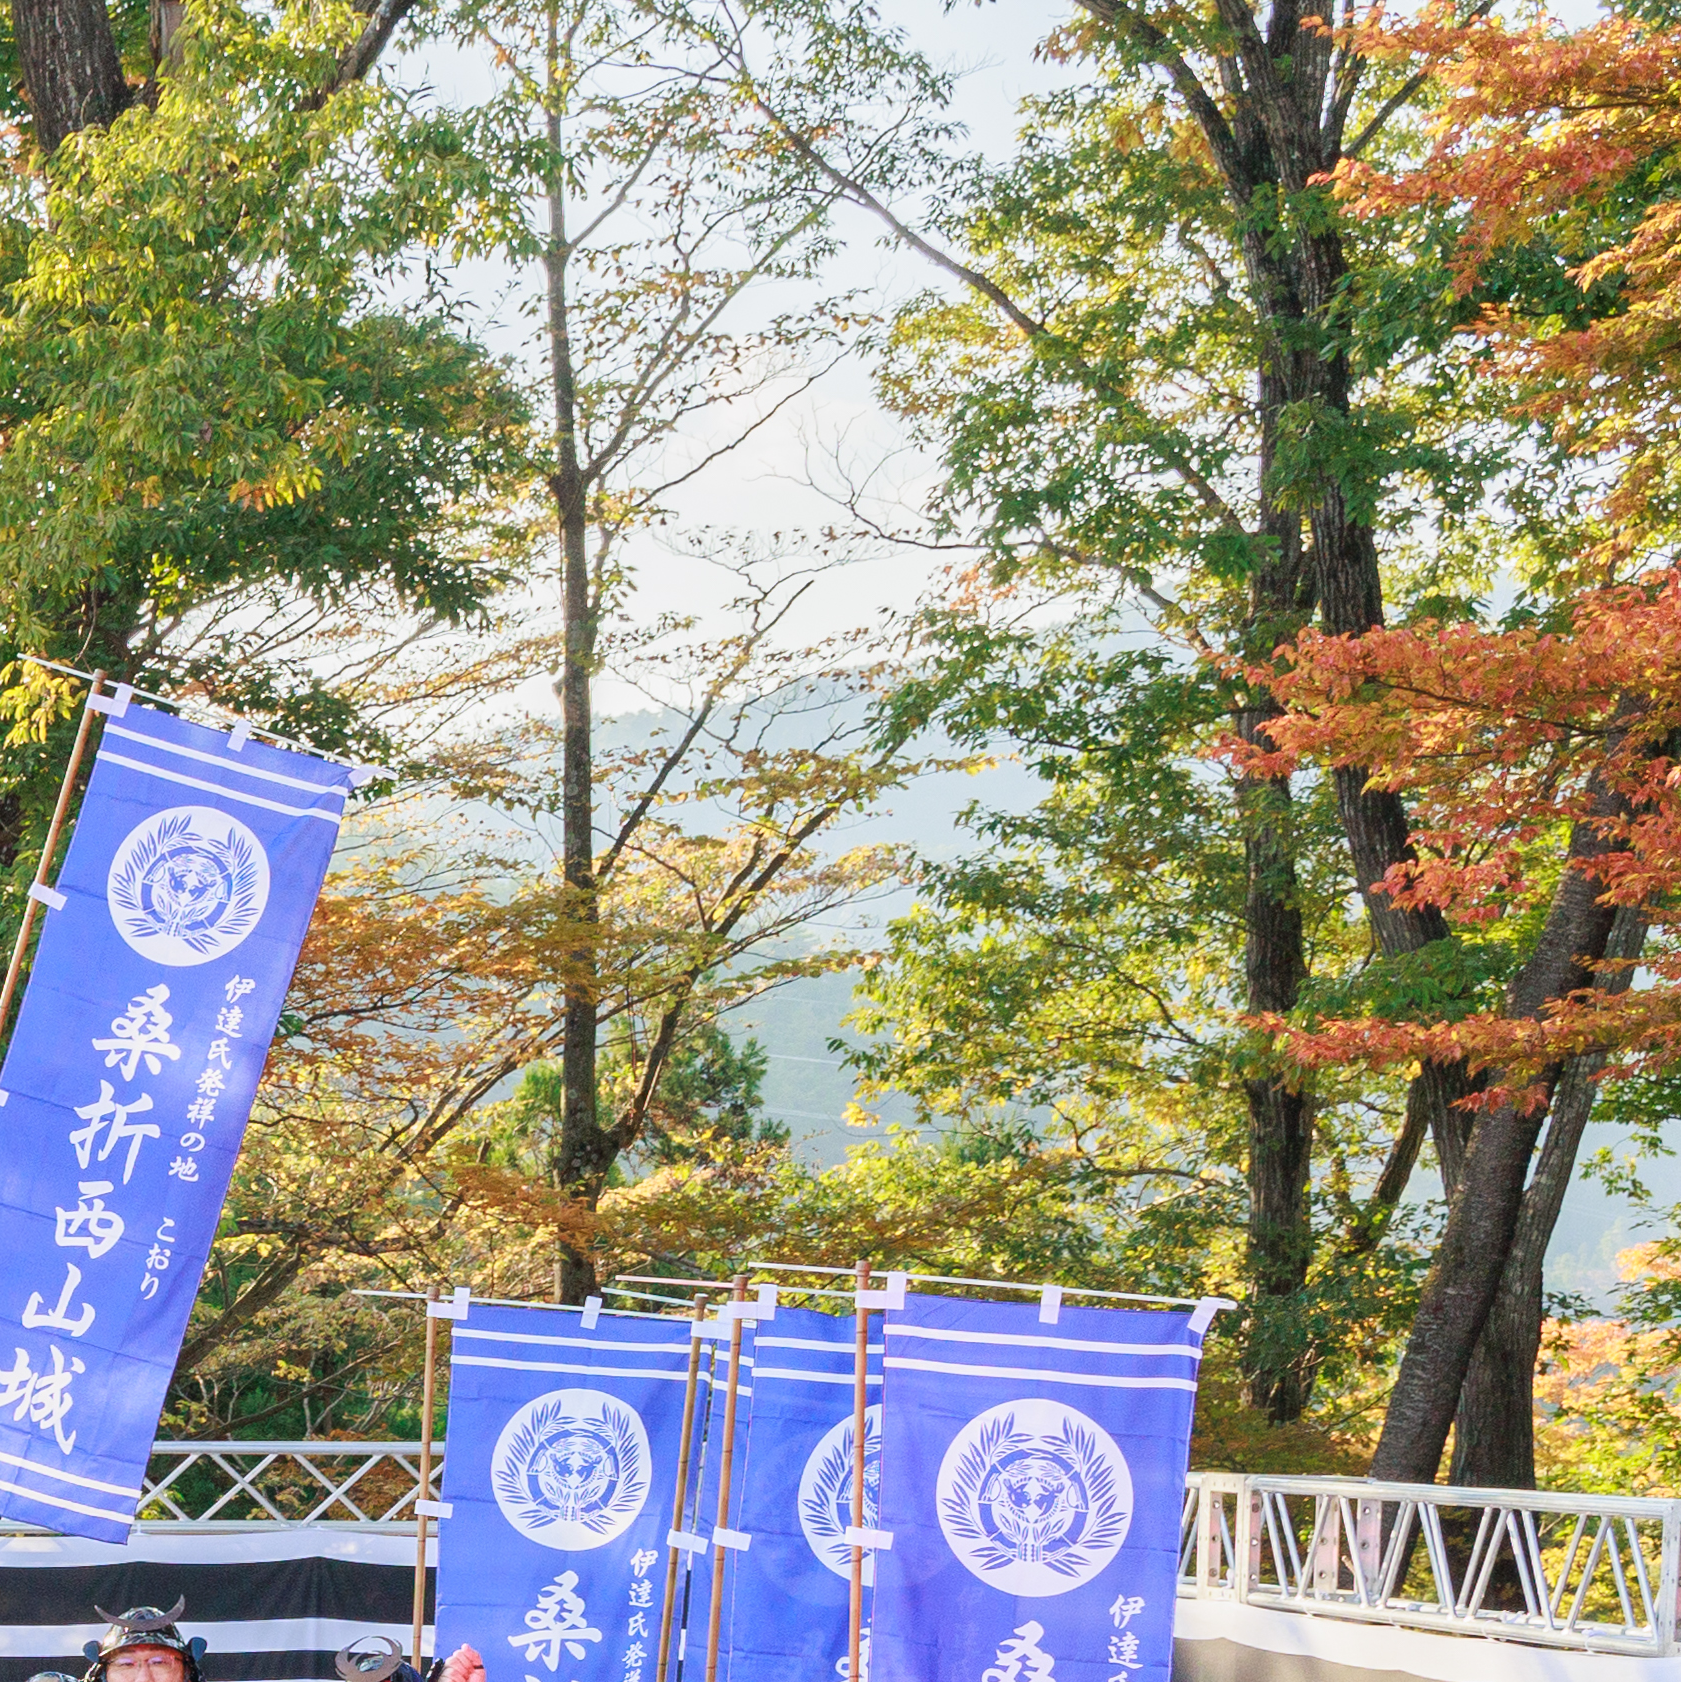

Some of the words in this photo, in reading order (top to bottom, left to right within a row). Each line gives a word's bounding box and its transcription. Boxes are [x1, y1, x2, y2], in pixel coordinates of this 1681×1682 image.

[167, 973, 256, 1183] 伊達氏発祥の地
[139, 1216, 176, 1301] こおり
